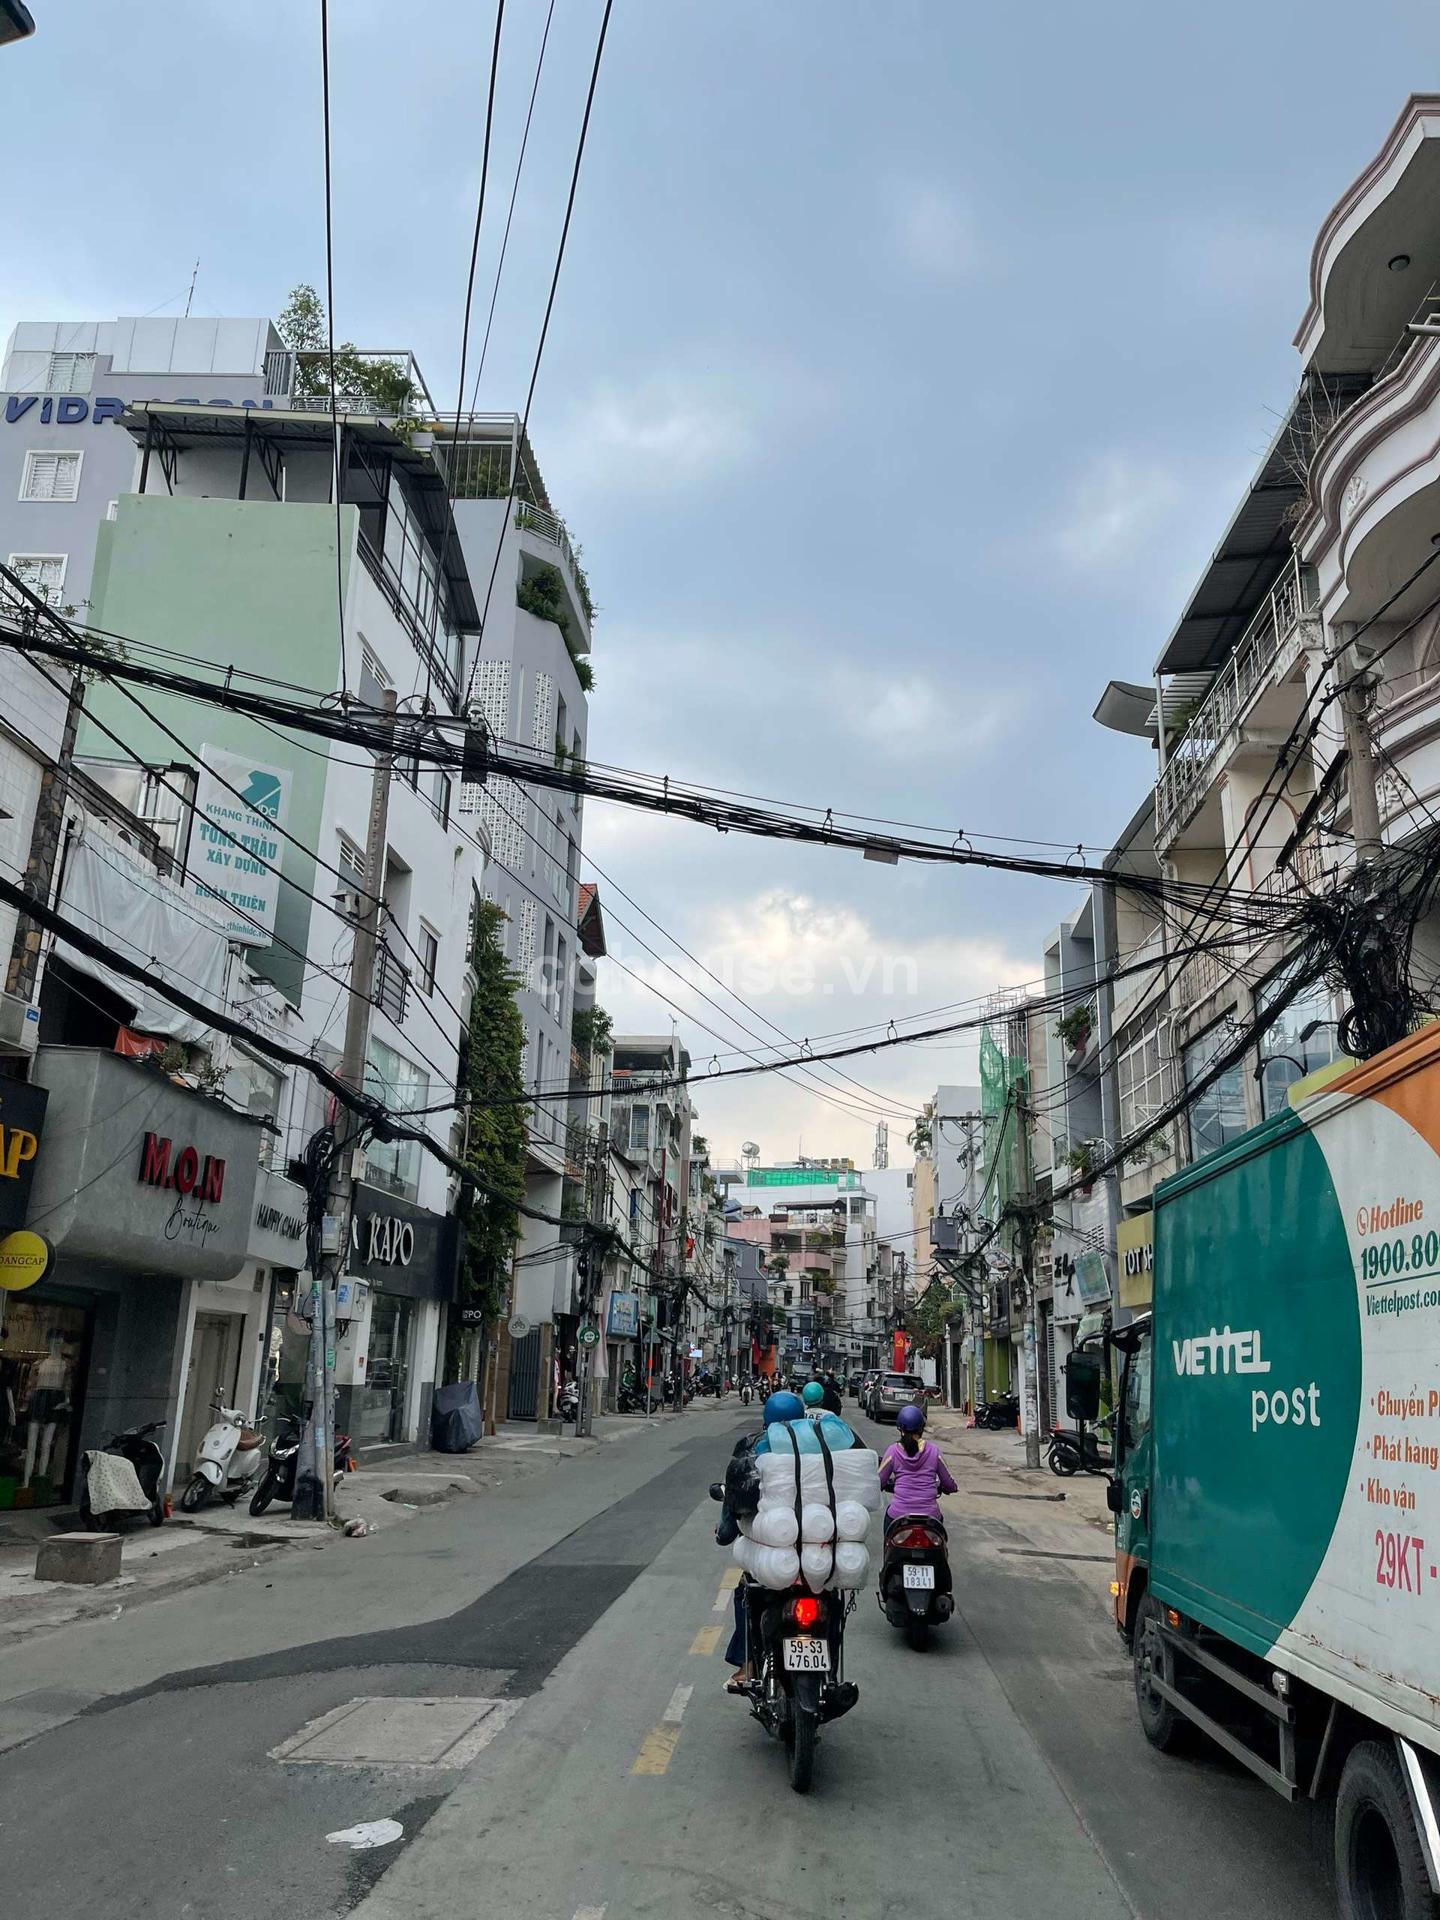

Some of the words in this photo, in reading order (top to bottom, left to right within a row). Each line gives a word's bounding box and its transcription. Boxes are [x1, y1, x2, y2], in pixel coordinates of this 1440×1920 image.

[206, 803, 242, 822] KHANG
[206, 848, 232, 866] XÂY
[138, 1131, 226, 1204] M.O.N
[164, 1194, 221, 1248] Boutique
[1369, 1197, 1424, 1234] Hotline
[1361, 1230, 1440, 1281] 1900.80
[1252, 1381, 1321, 1432] post
[1377, 1383, 1424, 1421] Chuyển
[1428, 1390, 1440, 1418] P
[1373, 1434, 1402, 1462] Phát
[1405, 1436, 1439, 1470] hàng
[1367, 1477, 1391, 1505] Kho
[1393, 1482, 1416, 1517] vận
[1375, 1529, 1424, 1596] 29KT
[788, 1655, 828, 1669] 476.04
[790, 1640, 823, 1654] 59-S3
